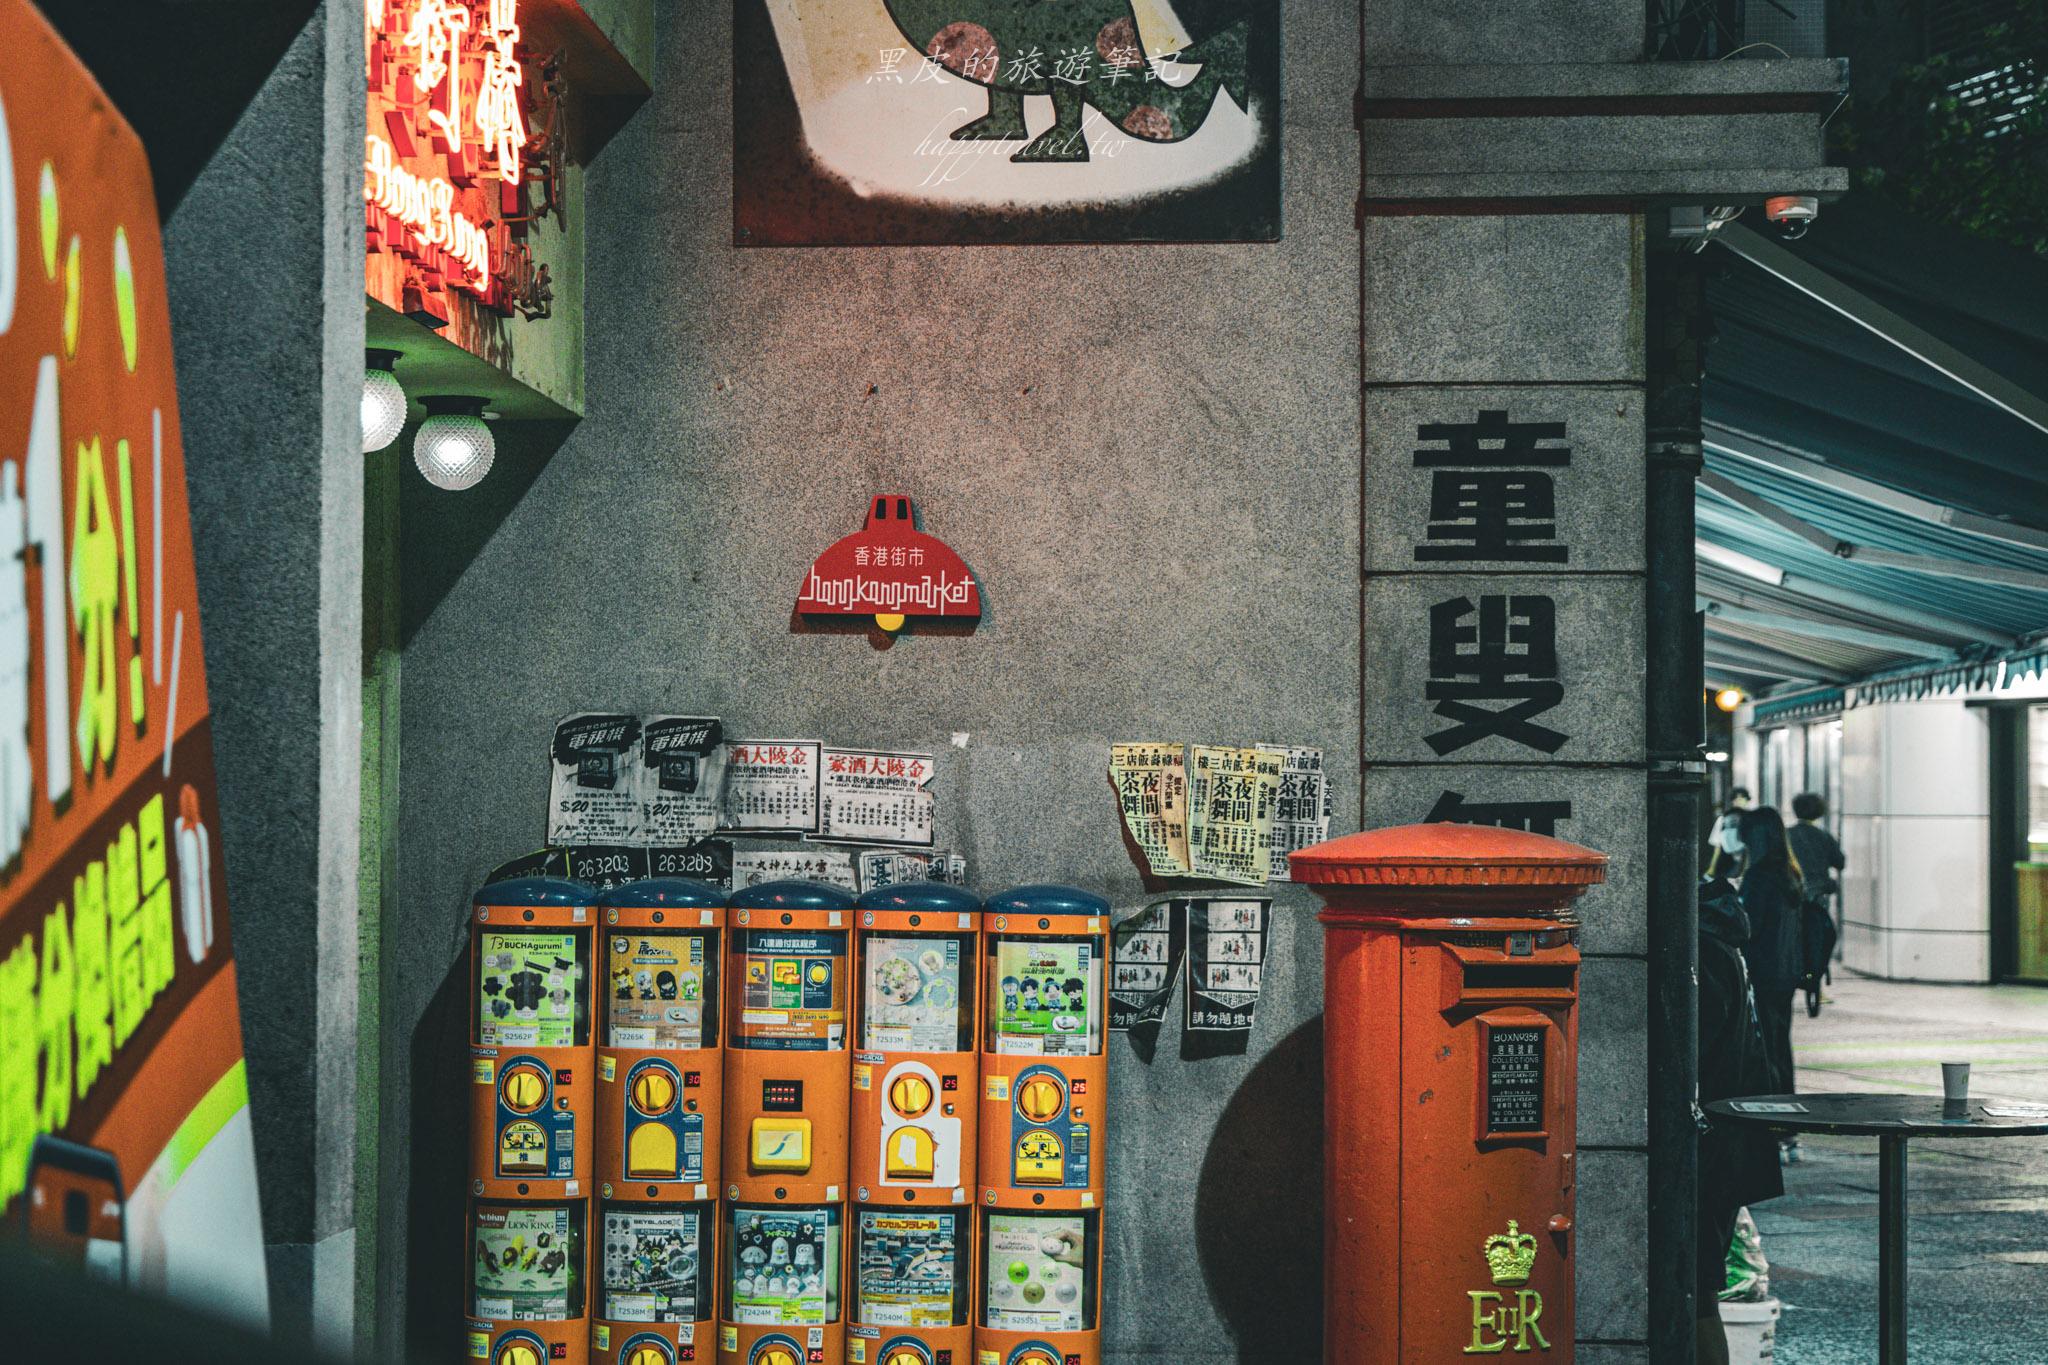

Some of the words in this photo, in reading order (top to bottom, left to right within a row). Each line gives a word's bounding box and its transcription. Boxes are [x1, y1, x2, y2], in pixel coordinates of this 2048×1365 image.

[854, 545, 926, 567] 香港街市
[569, 726, 626, 749] 電視機
[651, 730, 709, 752] 電視機
[577, 854, 631, 878] 263203
[504, 941, 562, 951] BUCHAgurumi
[1491, 1056, 1539, 1064] COLLECTIONS
[559, 1073, 572, 1082] 40
[688, 1074, 700, 1084] 30
[943, 1079, 957, 1088] 25
[1071, 1082, 1085, 1093] 25
[508, 1221, 528, 1230] LION
[529, 1221, 555, 1230] KING
[553, 1346, 566, 1356] 30
[681, 1348, 695, 1358] 25
[810, 1350, 823, 1360] 25
